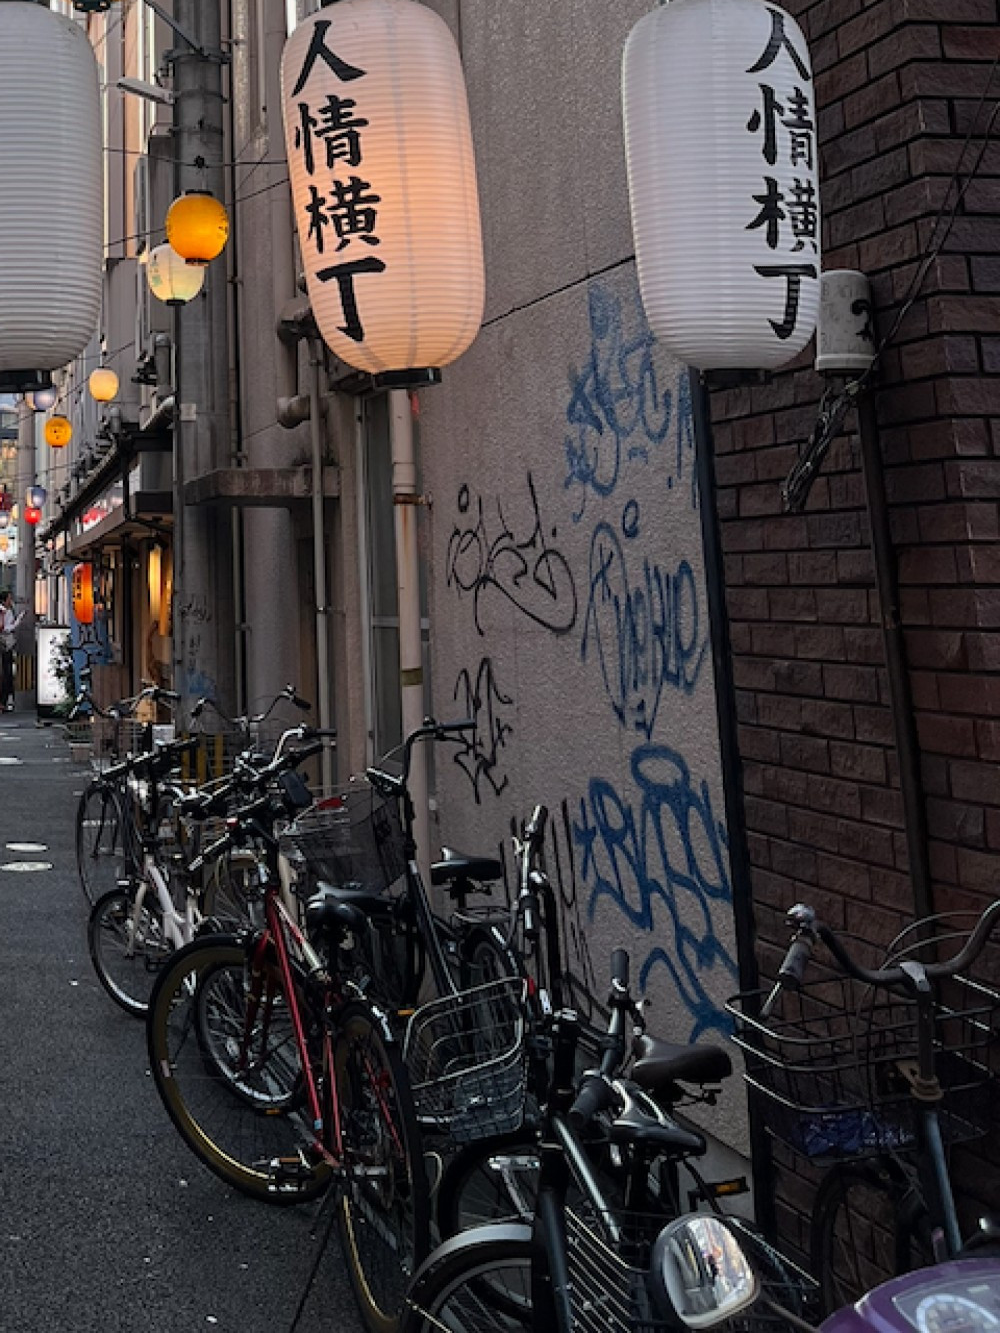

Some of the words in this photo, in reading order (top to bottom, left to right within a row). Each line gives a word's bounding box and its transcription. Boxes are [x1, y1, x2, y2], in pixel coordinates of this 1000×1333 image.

[291, 19, 386, 343] 人情横丁
[745, 6, 819, 340] 人情横丁
